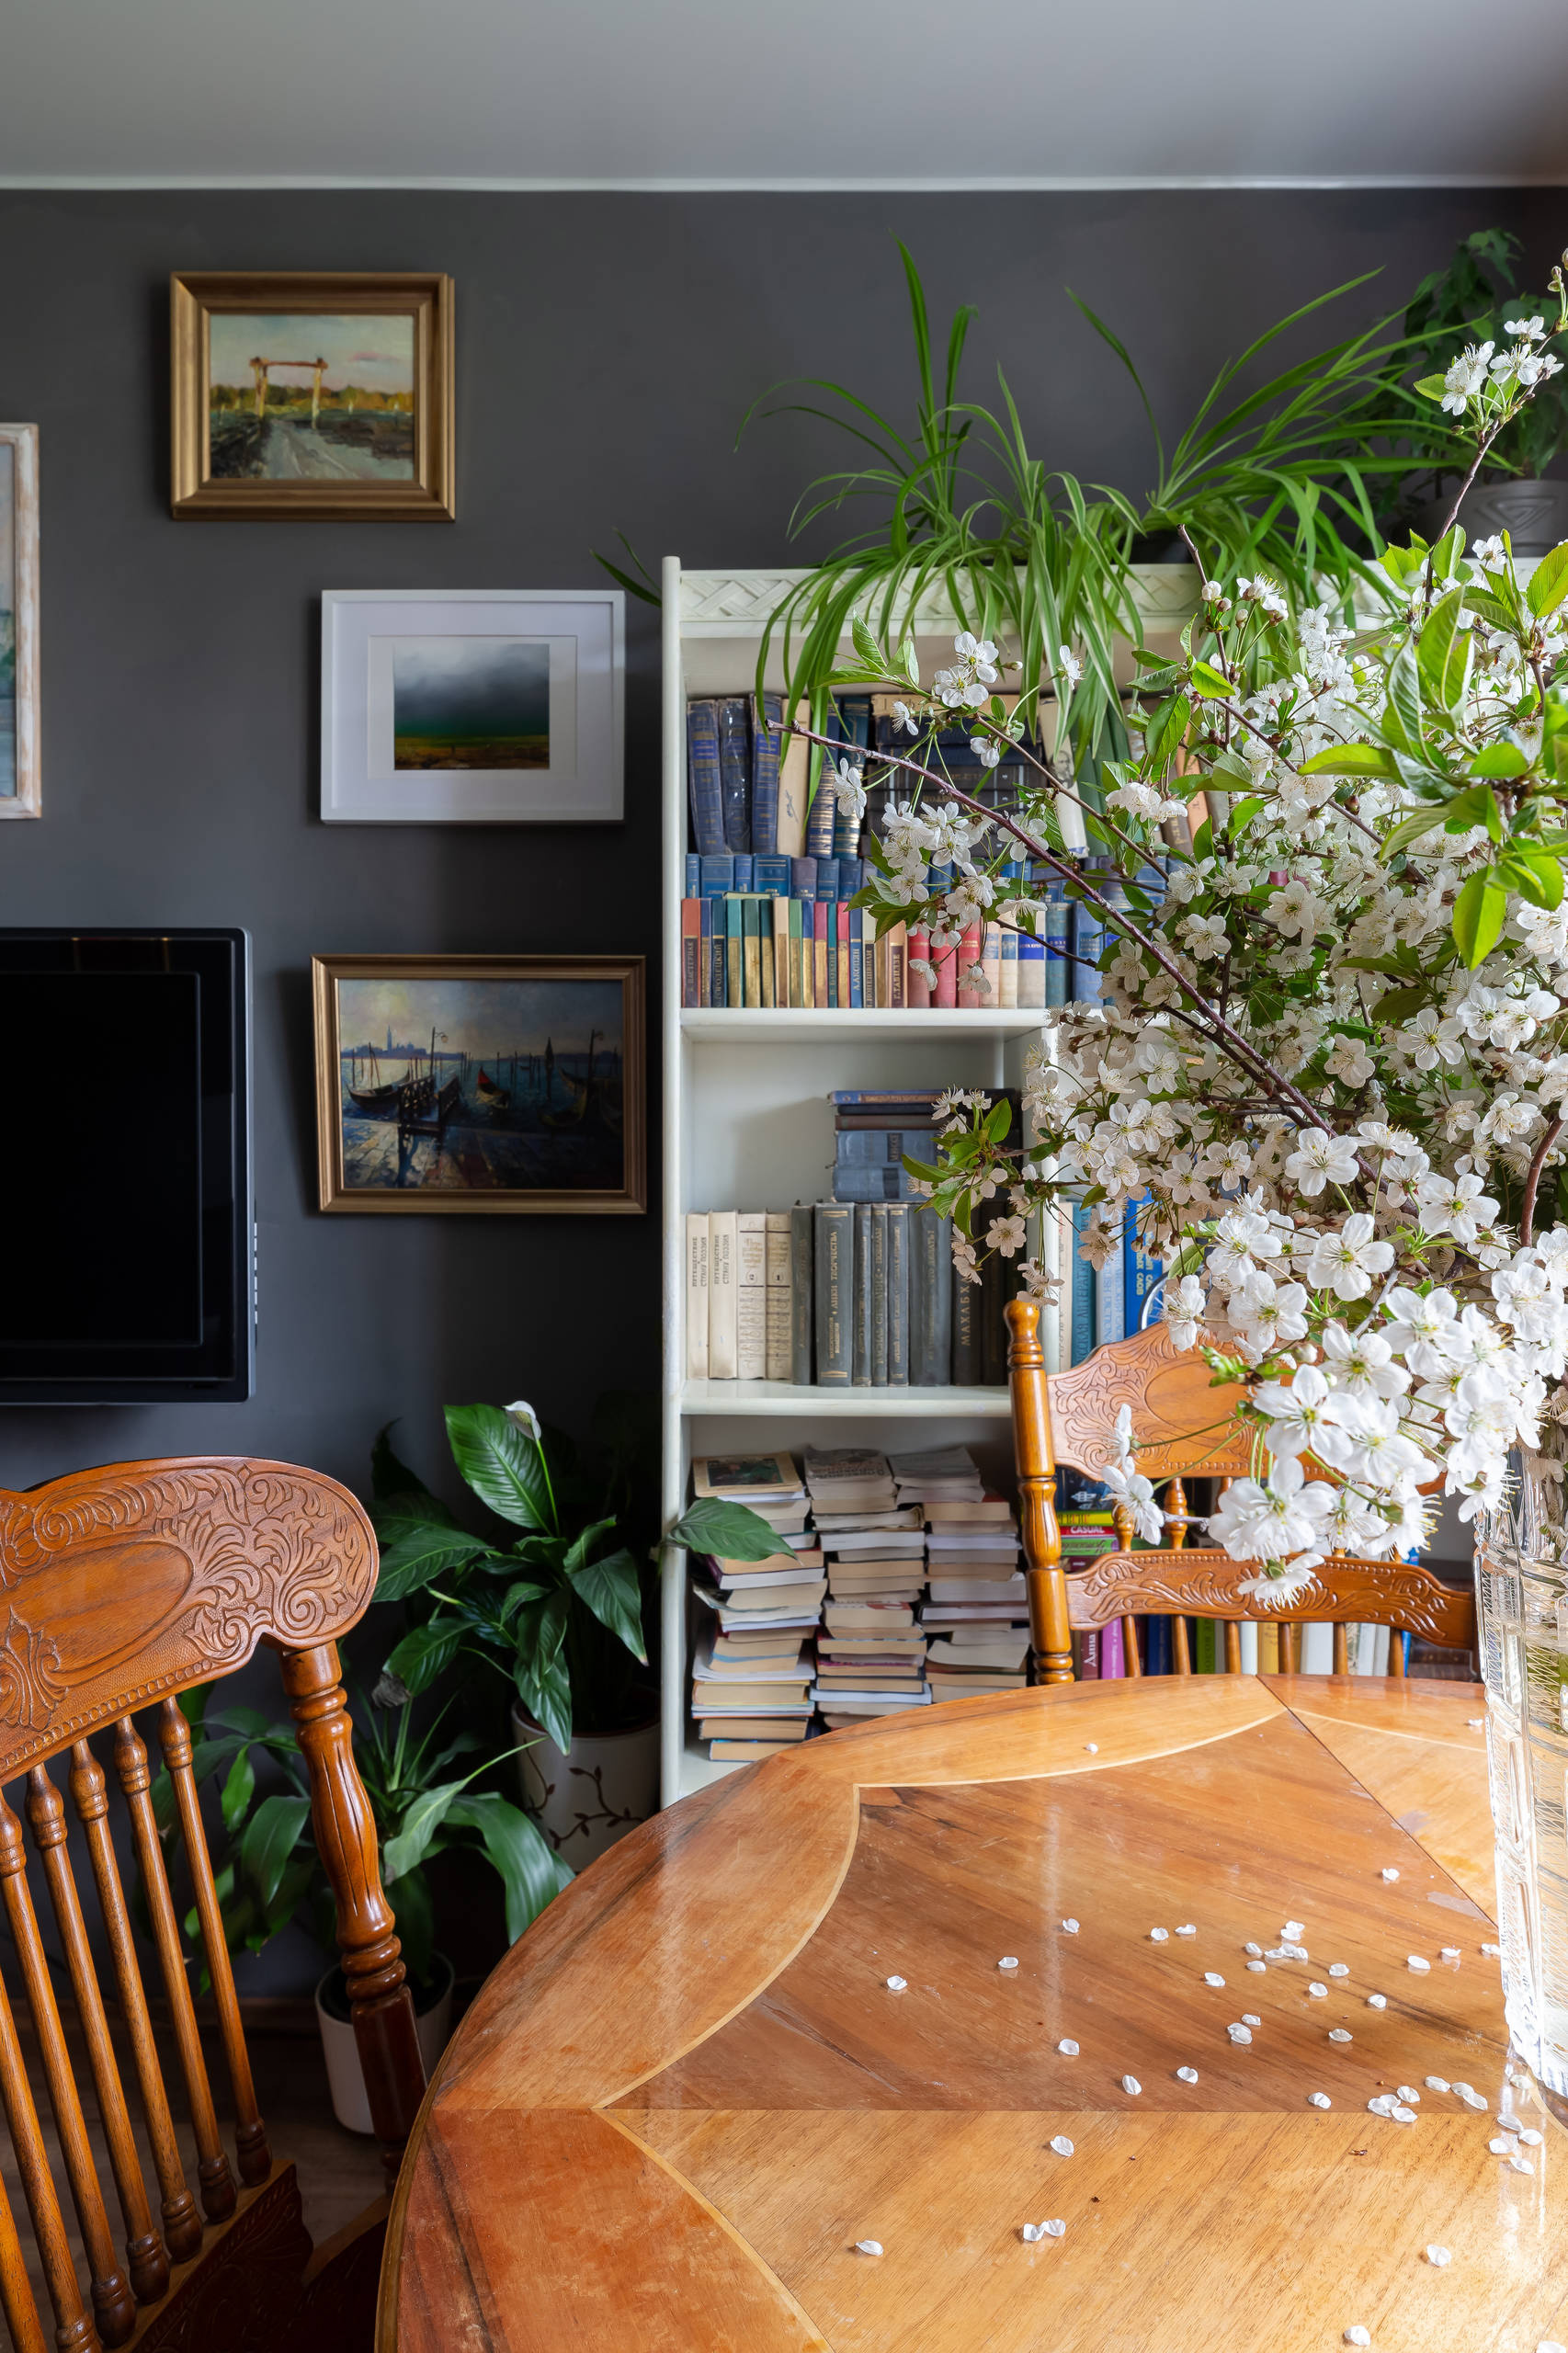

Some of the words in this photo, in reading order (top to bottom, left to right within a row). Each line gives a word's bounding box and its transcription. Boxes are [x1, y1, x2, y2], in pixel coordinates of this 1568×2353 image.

[830, 1232, 838, 1280] ТВОРЧЕСТВА
[960, 1278, 971, 1346] МАХАБХ
[1075, 1256, 1089, 1318] ЛИТЕРАТУР
[1070, 1526, 1106, 1534] CASUAL
